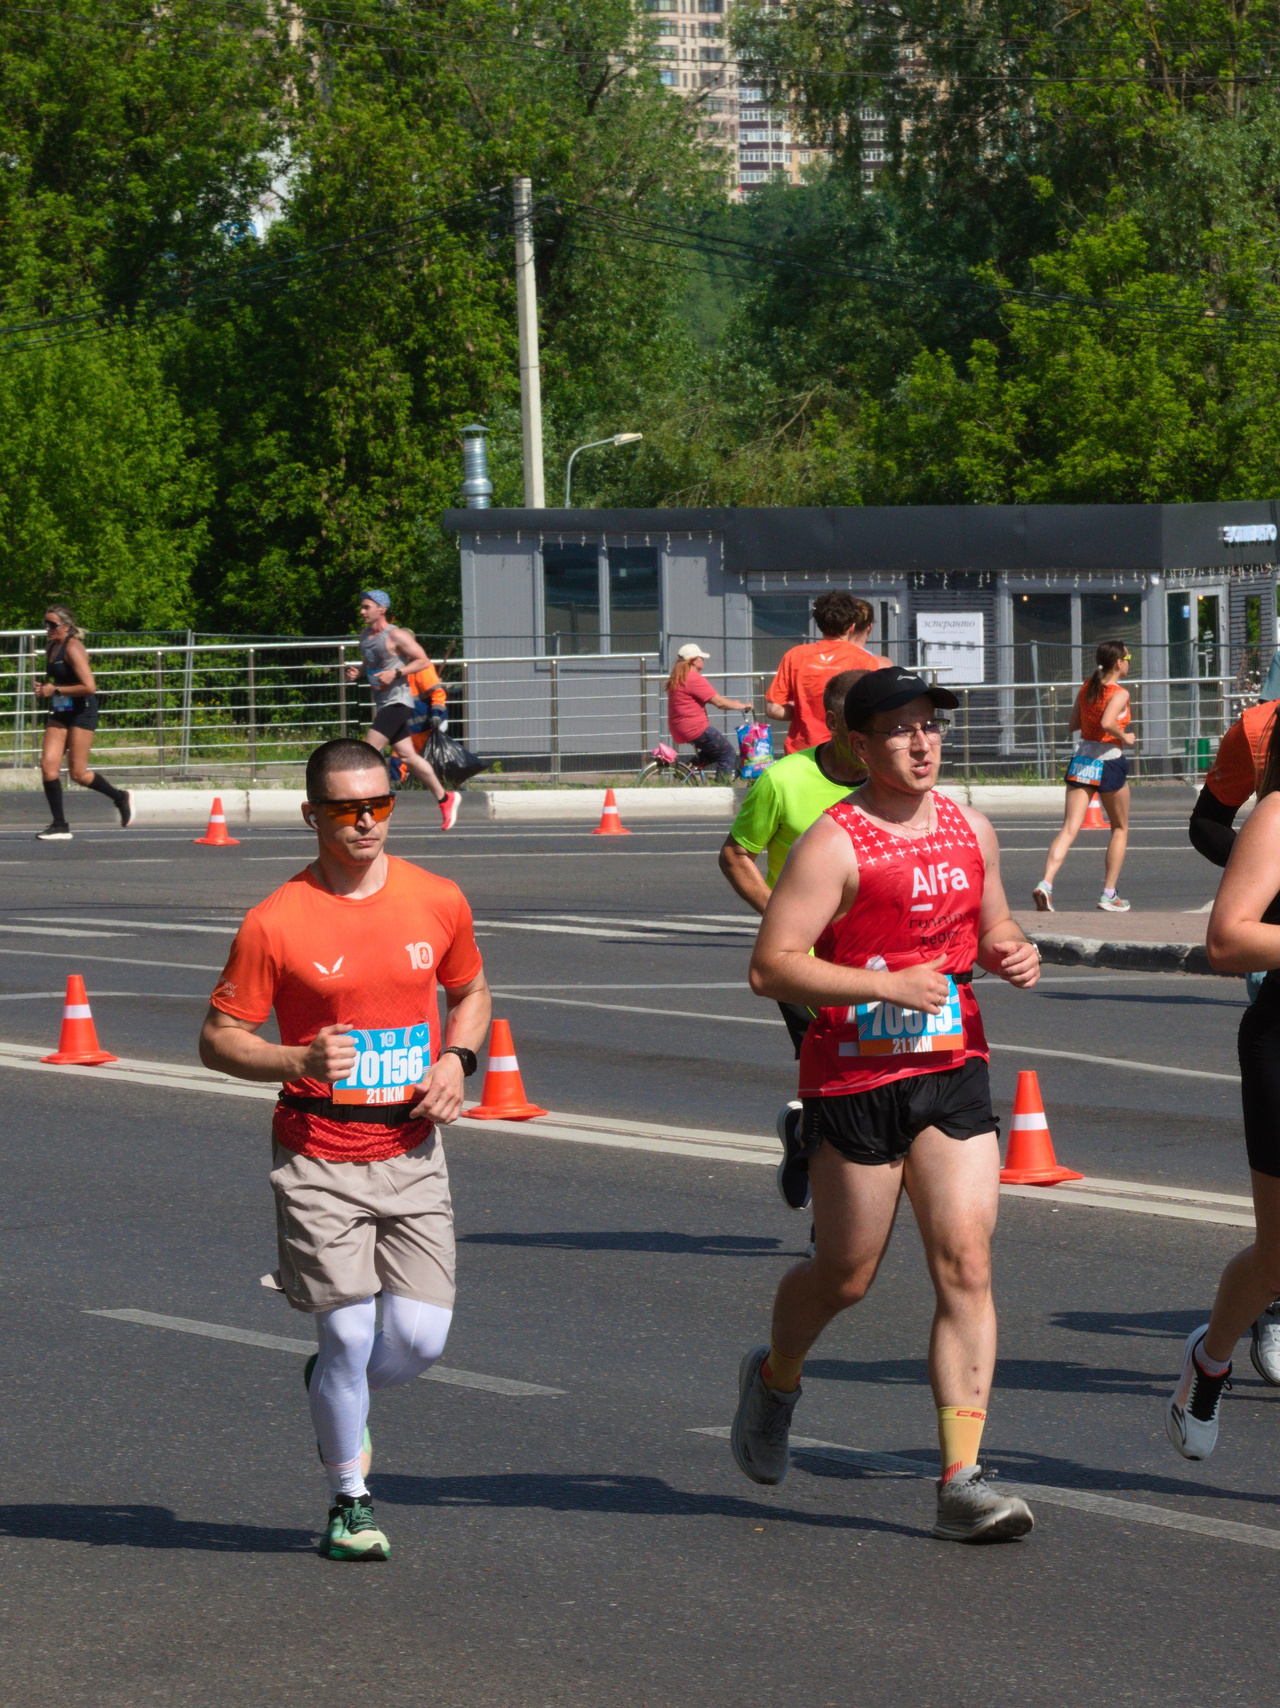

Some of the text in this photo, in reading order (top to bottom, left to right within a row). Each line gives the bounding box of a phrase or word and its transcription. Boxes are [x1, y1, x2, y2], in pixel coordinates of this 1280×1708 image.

[911, 861, 970, 899] Alfa
[909, 910, 970, 929] runnin
[404, 941, 434, 970] 10
